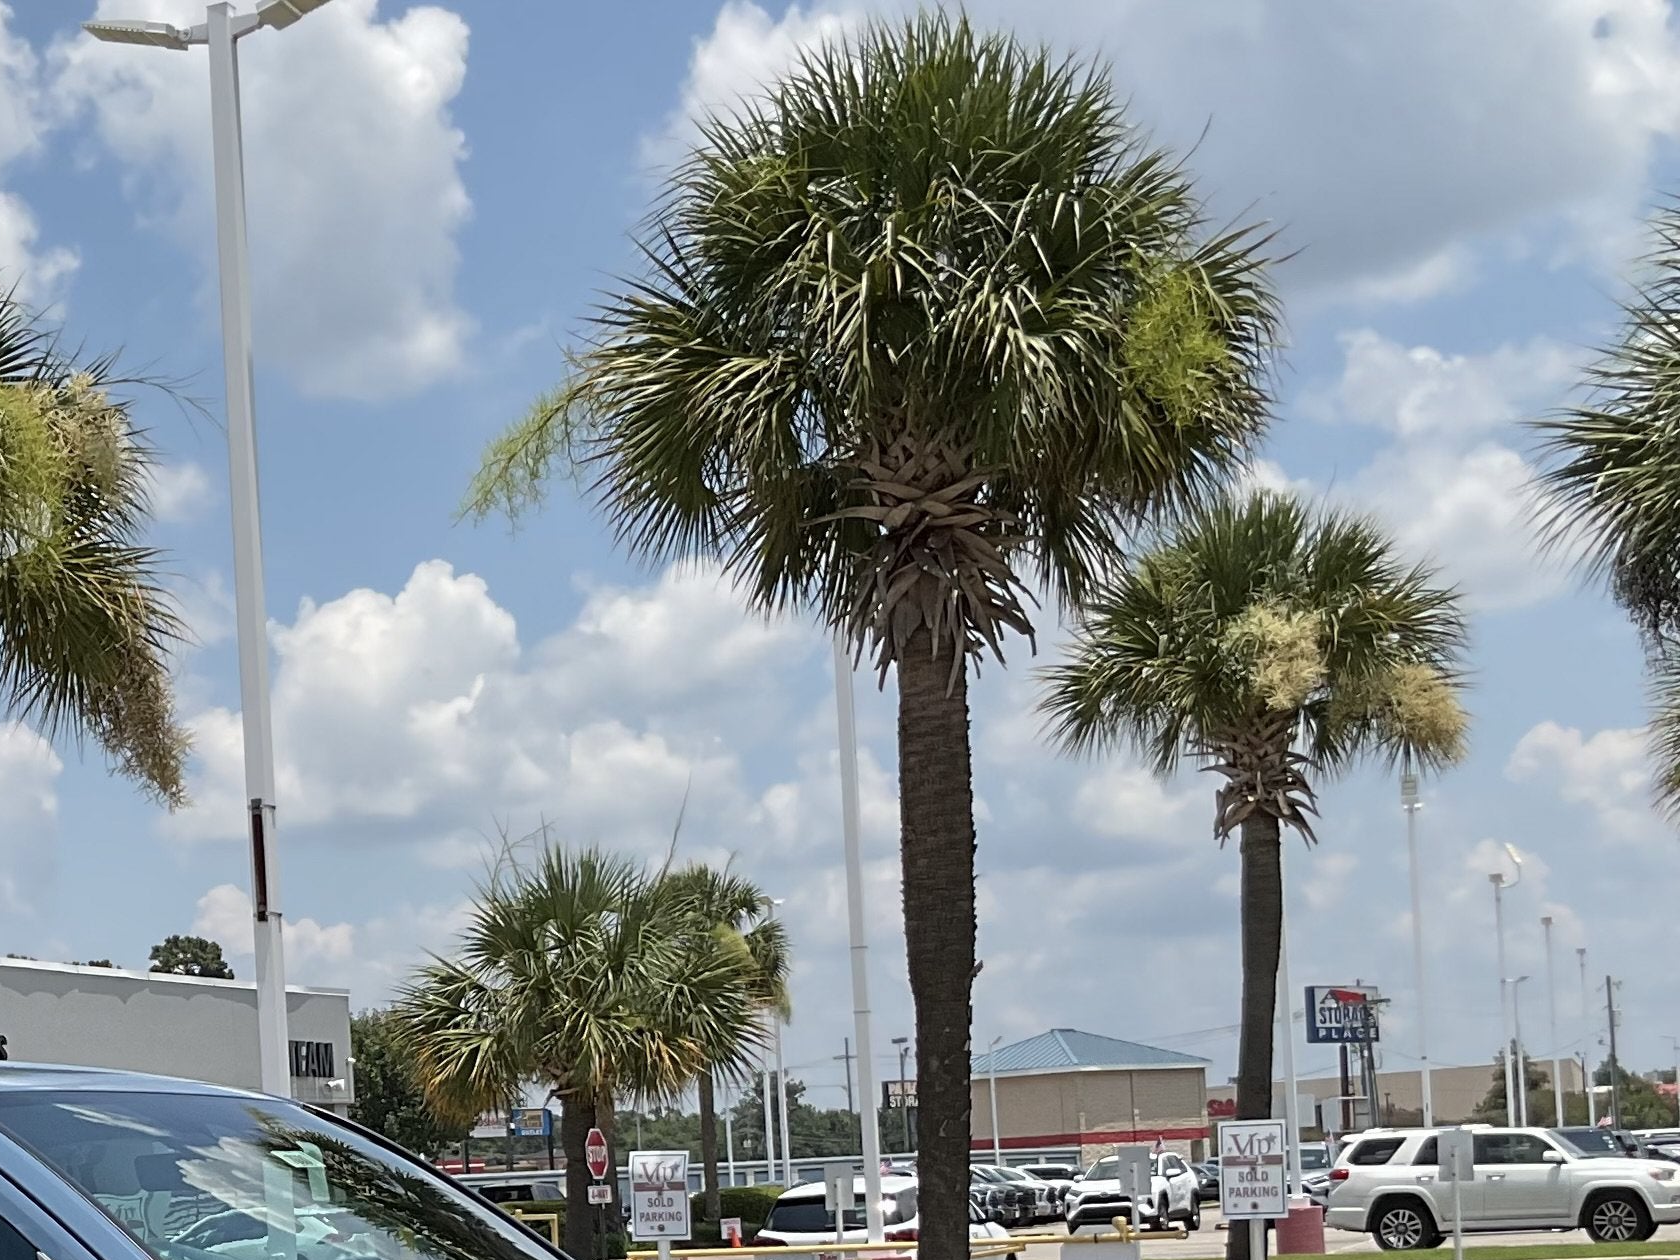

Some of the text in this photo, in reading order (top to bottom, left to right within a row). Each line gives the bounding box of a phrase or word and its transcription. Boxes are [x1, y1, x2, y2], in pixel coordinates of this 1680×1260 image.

[1318, 1027, 1378, 1039] PLACE
[588, 1145, 608, 1163] STOP
[1238, 1171, 1268, 1183] SOLD
[1228, 1186, 1279, 1199] PARKING
[647, 1197, 674, 1208] SOLD
[640, 1210, 683, 1222] PARKING
